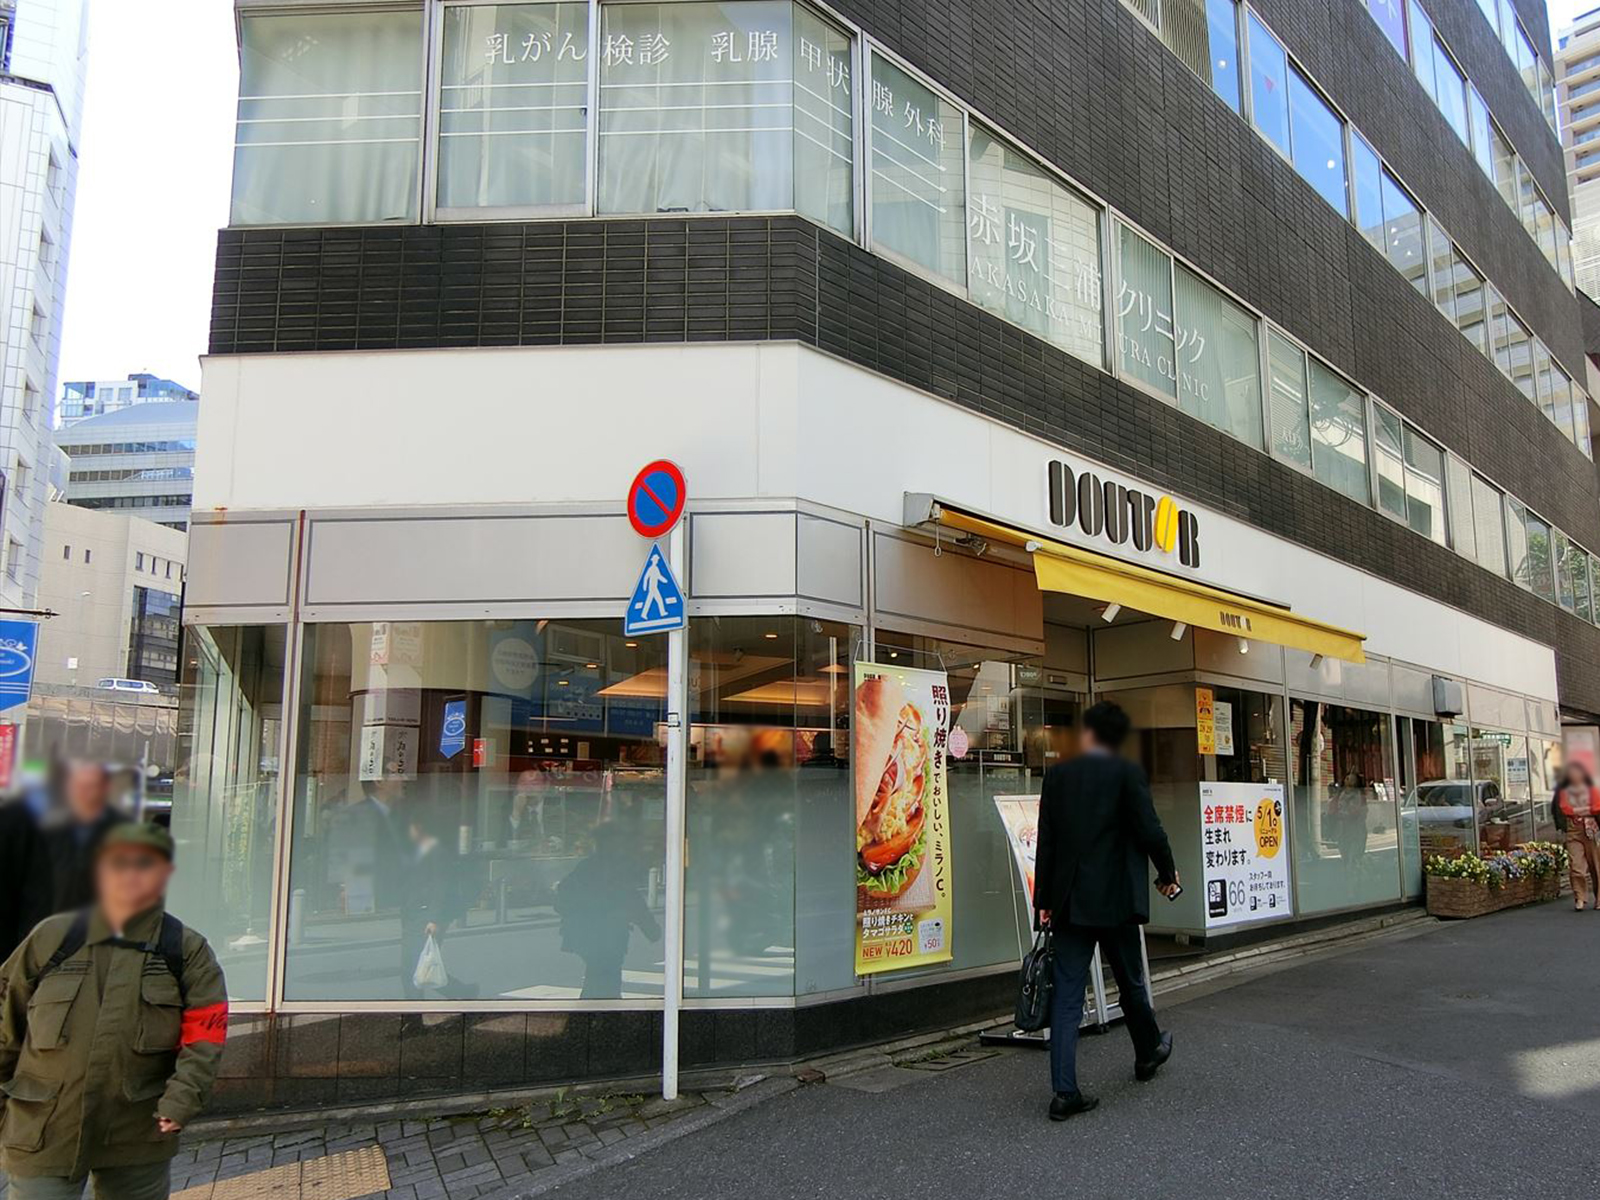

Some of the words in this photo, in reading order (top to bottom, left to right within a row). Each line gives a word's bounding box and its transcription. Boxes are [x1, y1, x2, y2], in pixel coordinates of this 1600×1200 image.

[970, 257, 1069, 326] AKASAKA
[1156, 355, 1209, 401] CLINIC
[1048, 460, 1200, 568] DOUTOR
[1204, 805, 1252, 824] 全席禁煙に
[1205, 827, 1231, 844] 生まれ
[1259, 836, 1278, 848] OPEN
[1206, 849, 1251, 868] 変わります。
[1229, 880, 1245, 906] 66
[863, 924, 906, 939] タマゴサラダ
[863, 946, 883, 957] NEW
